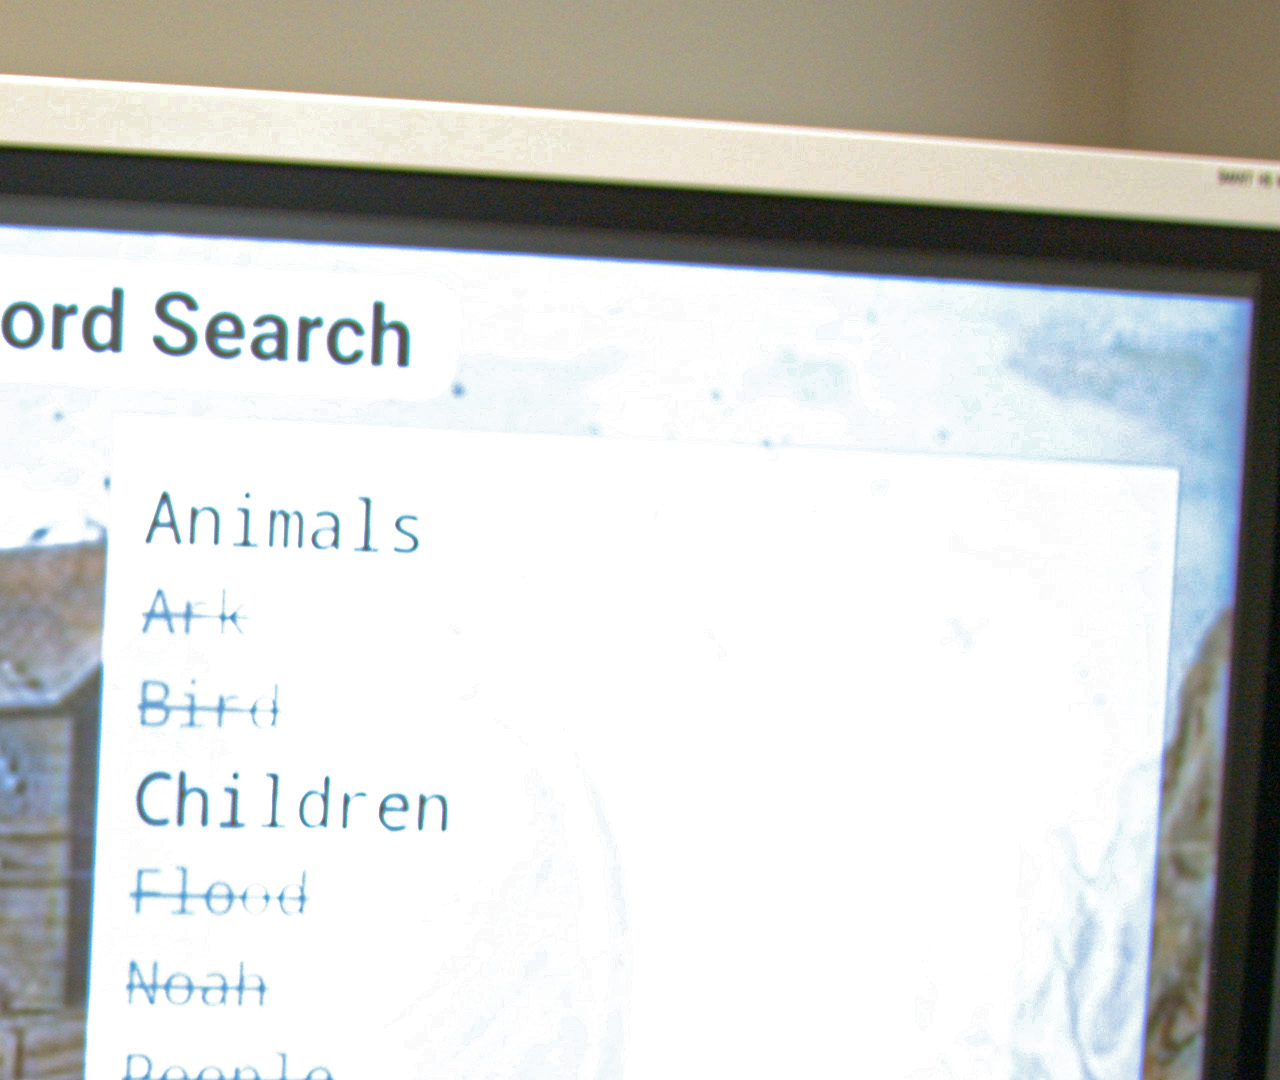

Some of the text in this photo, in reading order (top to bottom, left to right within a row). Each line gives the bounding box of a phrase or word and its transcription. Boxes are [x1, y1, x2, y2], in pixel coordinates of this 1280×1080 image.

[153, 292, 410, 367] Search
[146, 491, 419, 553] Animals
[142, 588, 248, 635] Ark
[137, 679, 280, 728] Bird
[136, 770, 448, 832] Children
[129, 866, 308, 915] Flood
[126, 960, 268, 1006] Noah
